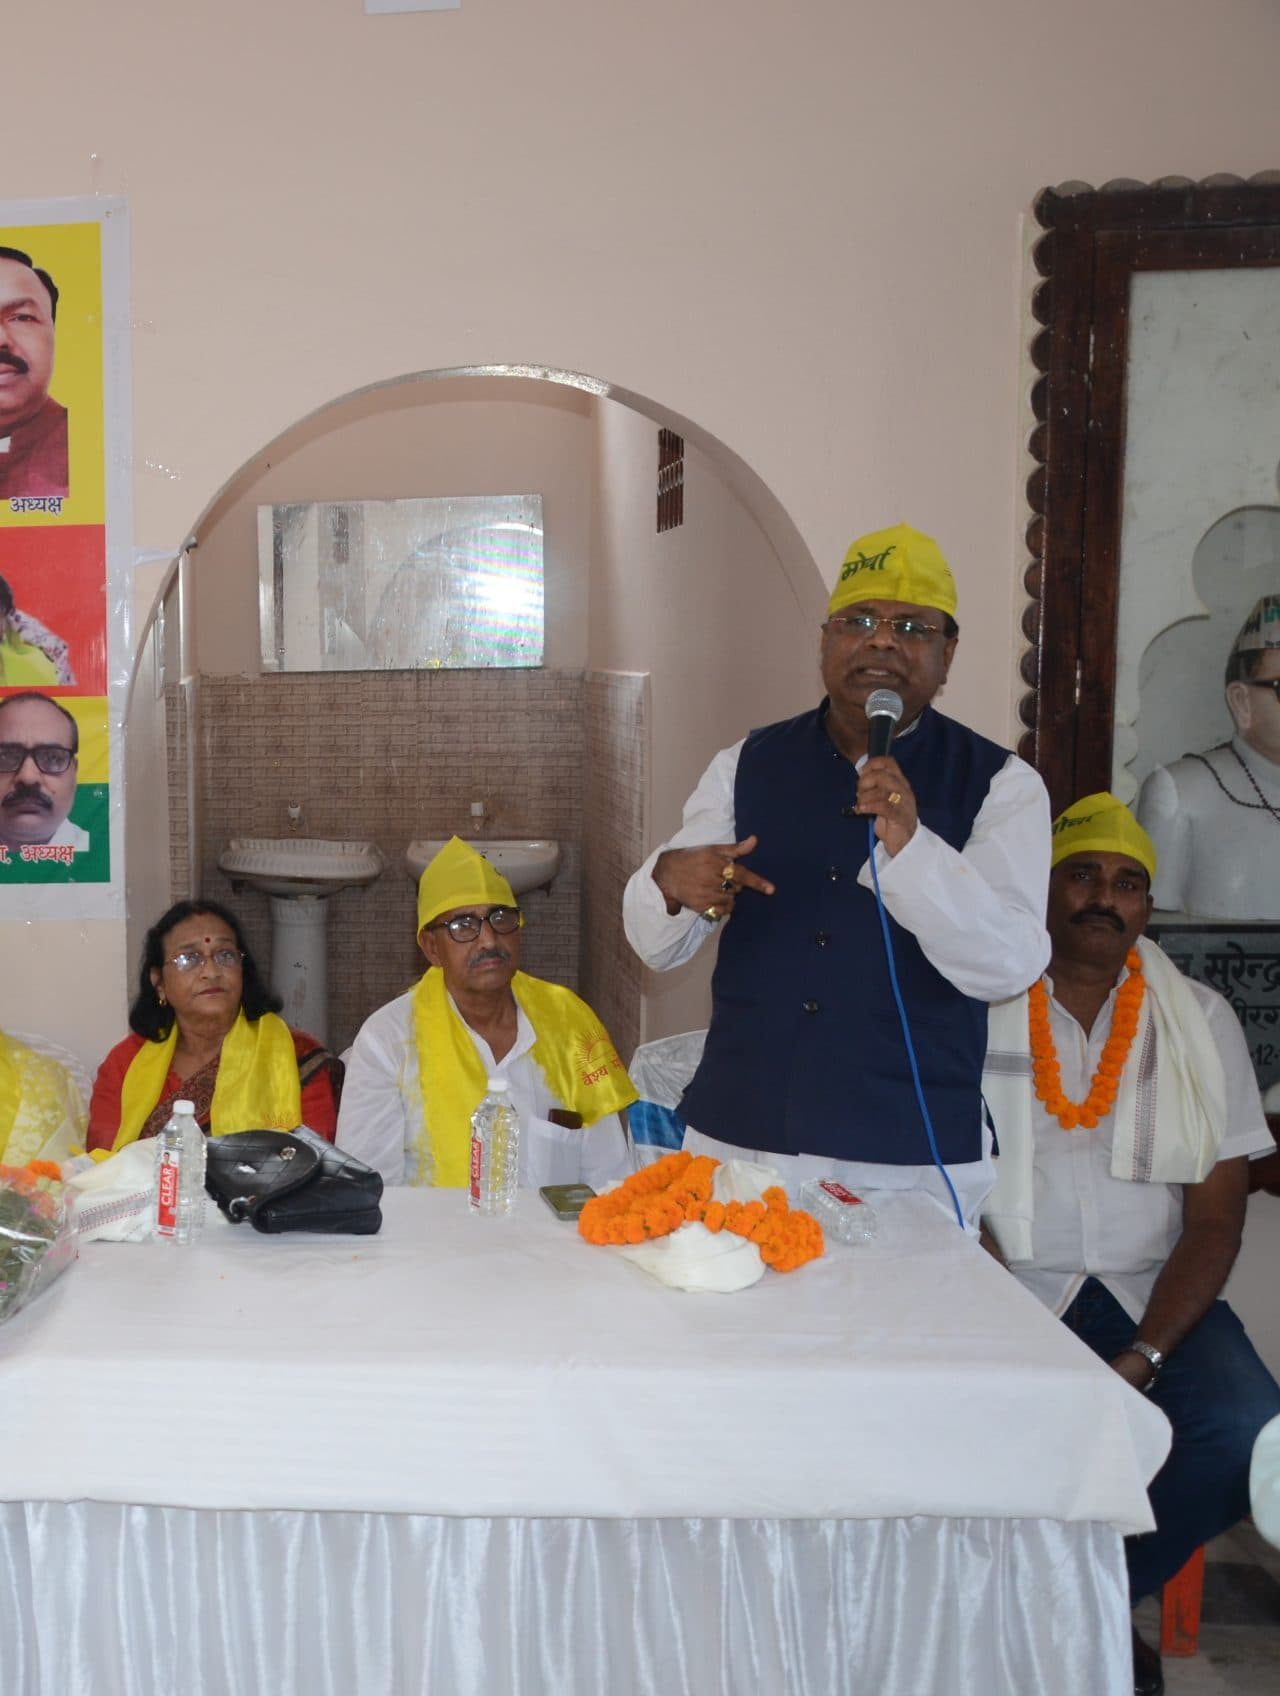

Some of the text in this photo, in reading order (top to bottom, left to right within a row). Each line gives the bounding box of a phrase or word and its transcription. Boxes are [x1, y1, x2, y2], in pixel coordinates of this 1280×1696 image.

[10, 495, 64, 515] अध्यक्ष
[841, 546, 896, 581] मोर्चा
[21, 844, 74, 864] अध्यक्ष
[161, 1168, 173, 1206] CLEAR
